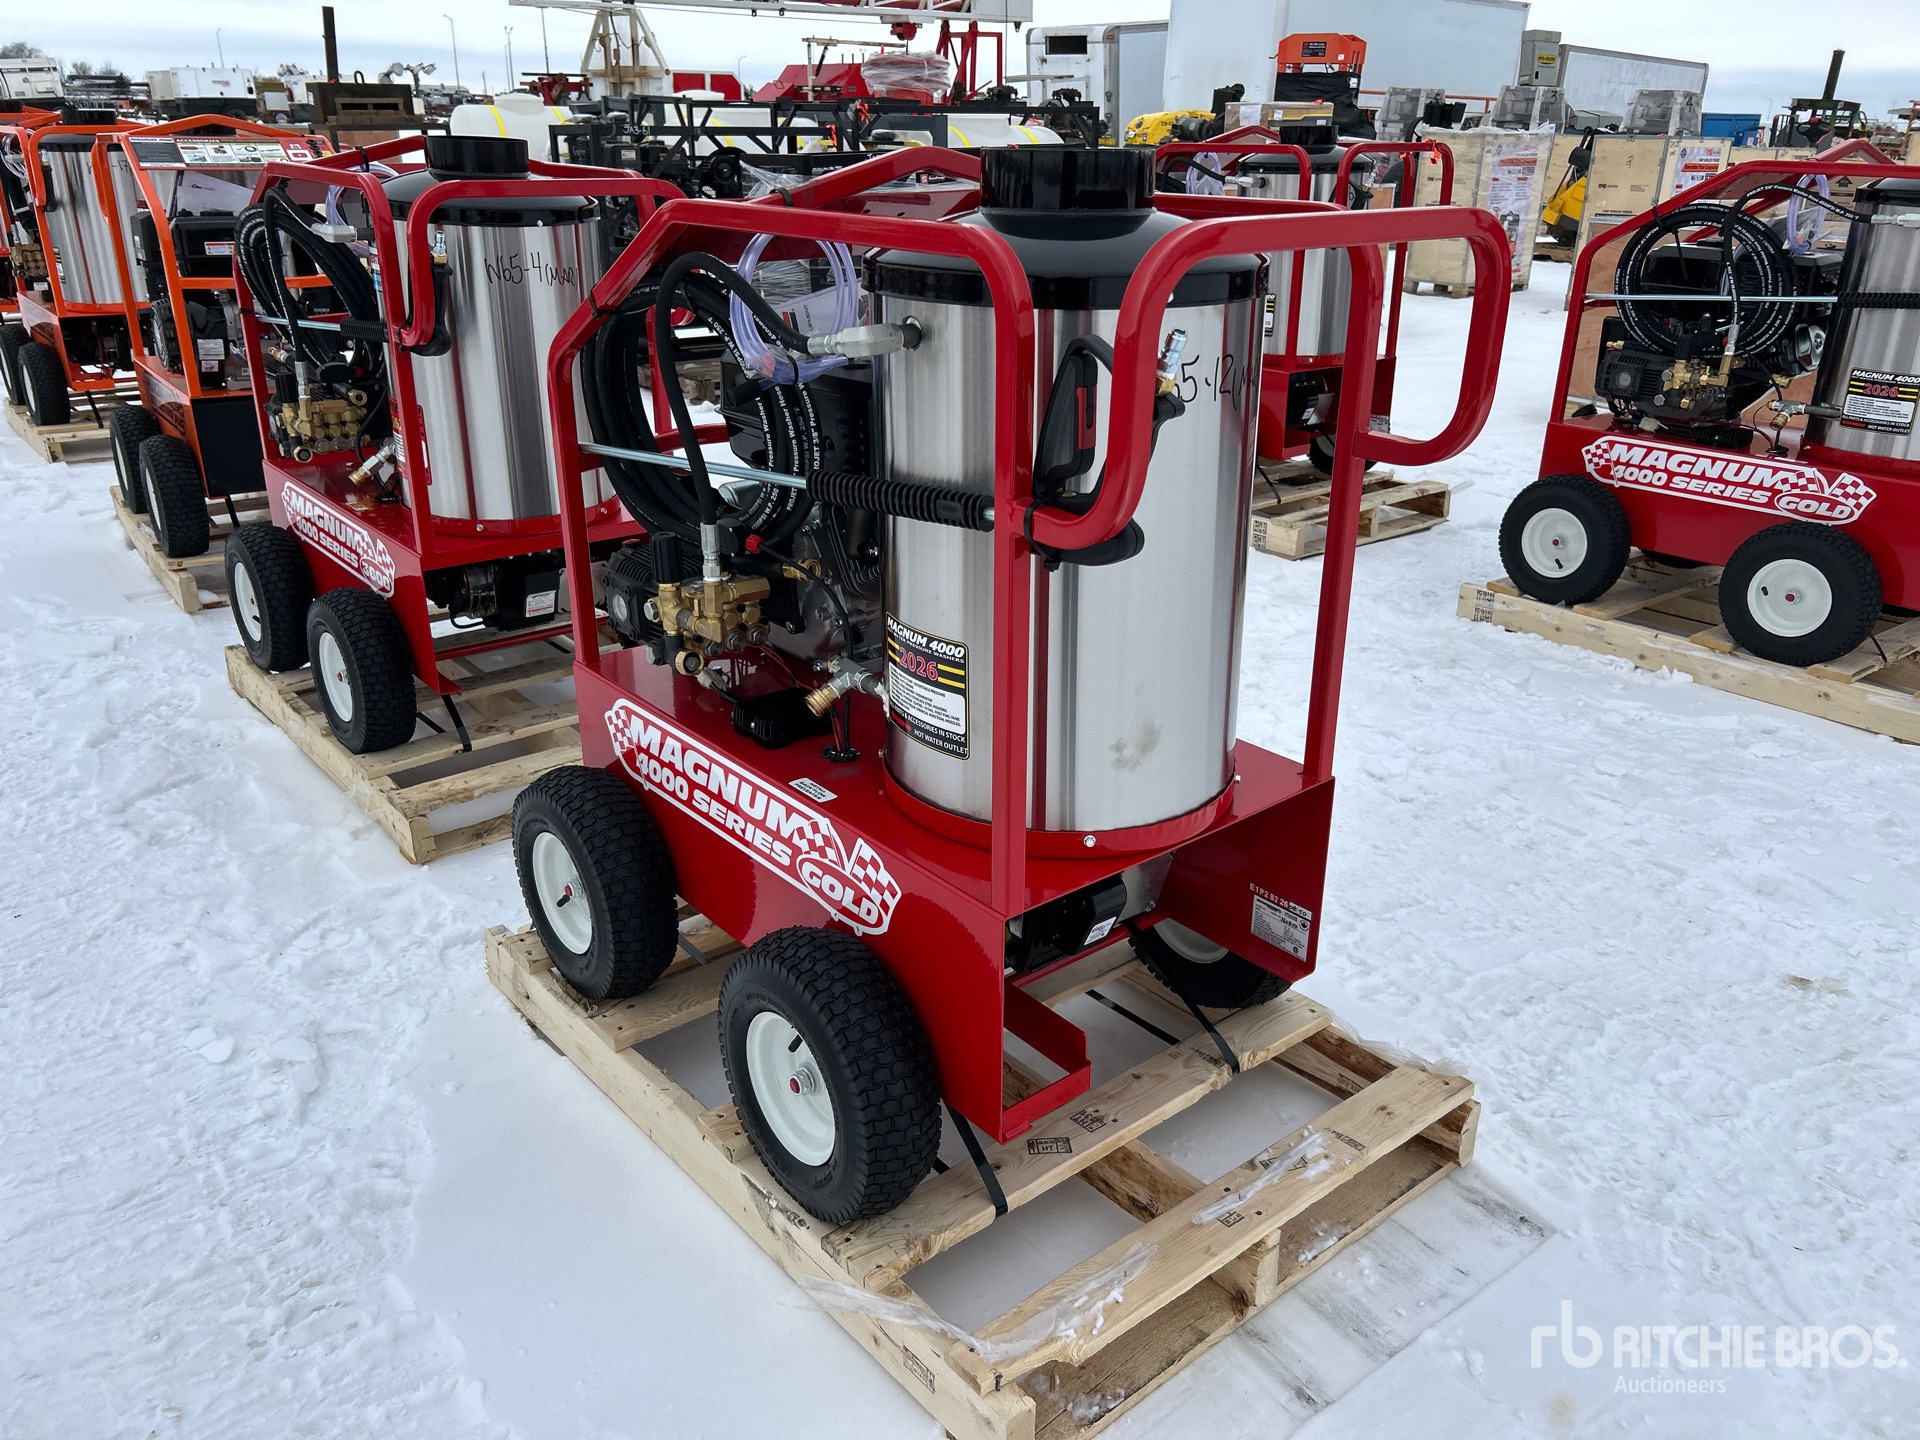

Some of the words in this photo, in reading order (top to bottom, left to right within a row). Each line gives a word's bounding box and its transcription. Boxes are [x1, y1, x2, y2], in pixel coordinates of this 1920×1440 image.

[713, 323, 725, 335] 250
[1852, 369, 1895, 381] MAGNUM
[1894, 375, 1920, 384] 4000
[1863, 382, 1899, 398] 2026
[775, 385, 786, 407] Hose
[802, 390, 817, 427] Pressure
[757, 402, 770, 433] Washer
[783, 407, 795, 438] Washer
[766, 433, 774, 467] Pressure
[792, 439, 800, 472] Pressure
[1609, 443, 1787, 490] MAGNUM
[1610, 464, 1669, 487] 4000
[1669, 476, 1772, 504] SERIES
[290, 490, 361, 551] MAGNUM
[1778, 495, 1851, 517] GOLD
[319, 531, 359, 569] SERIES
[361, 560, 391, 592] 3600
[887, 616, 928, 647] MAGNUM
[929, 640, 965, 658] 4000
[906, 641, 932, 655] PRESSURE
[933, 650, 965, 664] WASHERS
[899, 646, 939, 682] 2026
[907, 713, 938, 735] ACCESSORIES
[938, 728, 945, 737] IN
[945, 731, 966, 743] STOCK
[914, 728, 925, 739] HOT
[924, 733, 943, 747] WATER
[943, 741, 968, 755] OUTLET
[630, 713, 804, 848] MAGNUM
[635, 750, 689, 801] 4000
[691, 789, 793, 867] SERIES
[800, 860, 880, 925] GOLD
